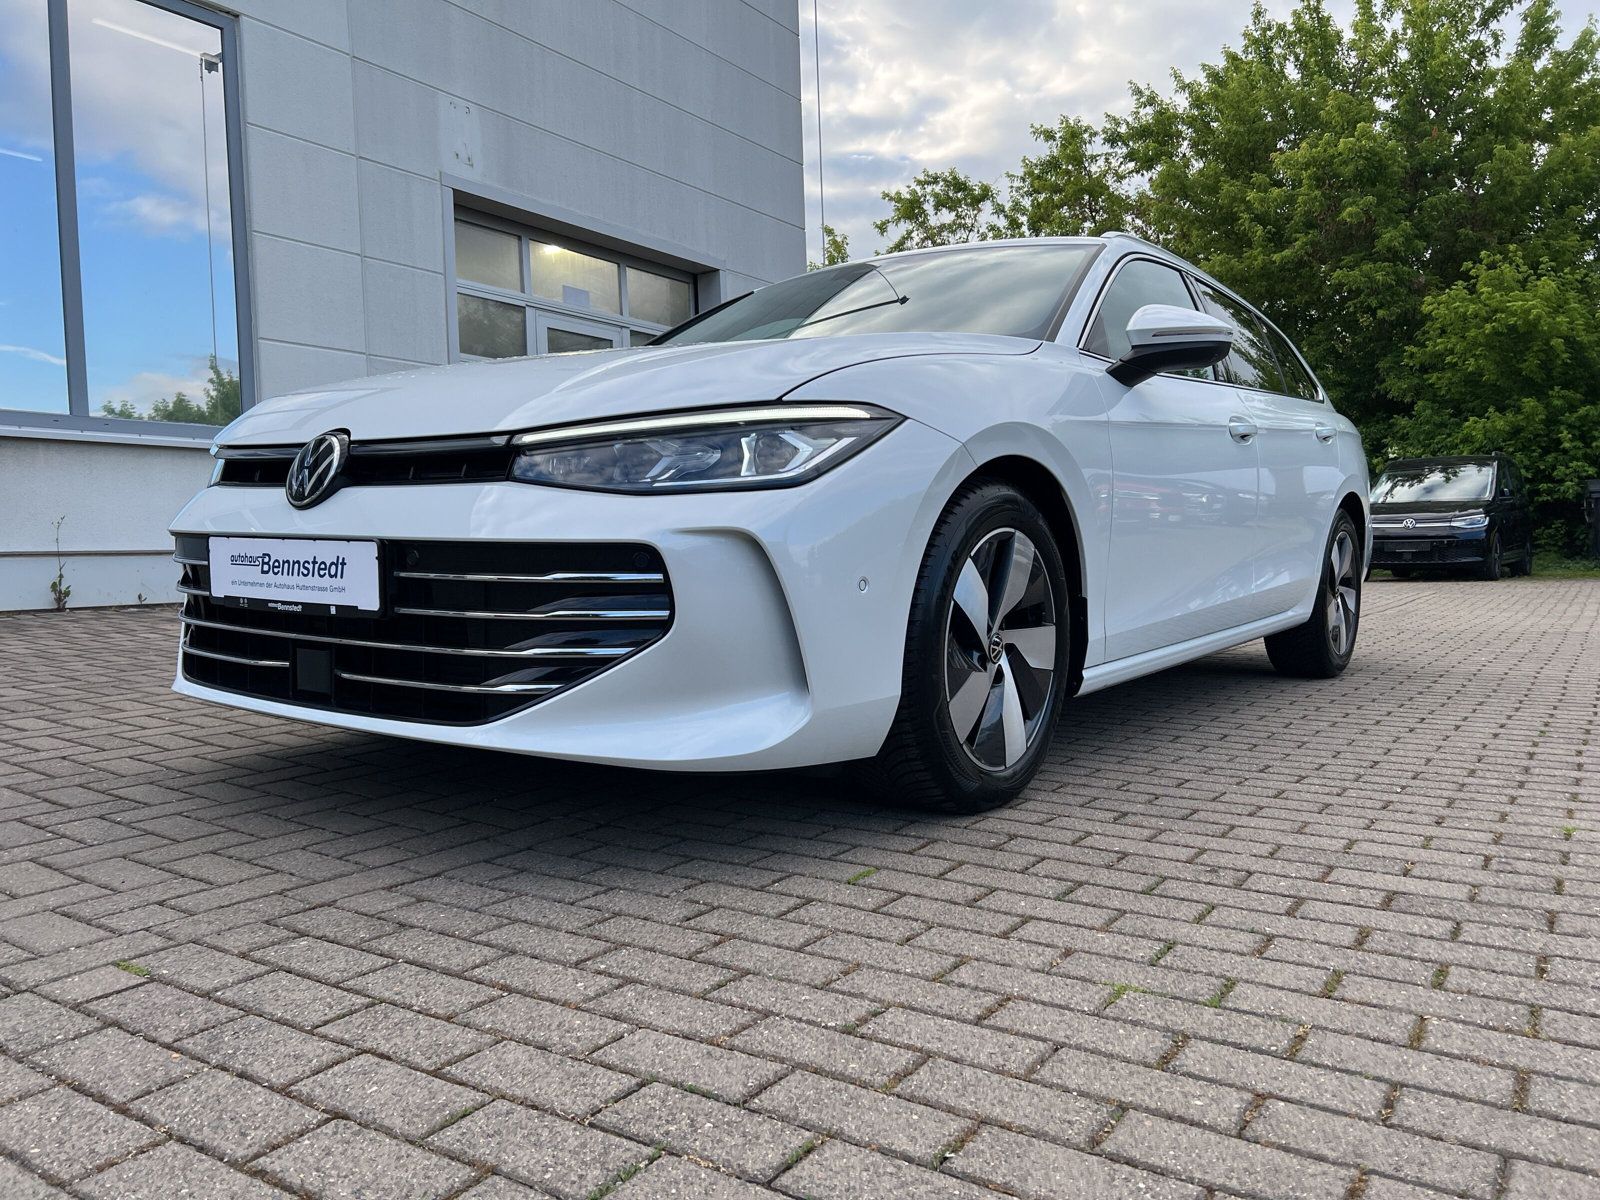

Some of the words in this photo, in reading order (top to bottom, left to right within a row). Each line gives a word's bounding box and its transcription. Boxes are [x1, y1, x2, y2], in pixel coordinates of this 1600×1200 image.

[230, 552, 262, 567] autohaus
[260, 553, 347, 579] Bennstedt
[273, 582, 295, 591] Autohaus
[329, 585, 346, 594] GmbH
